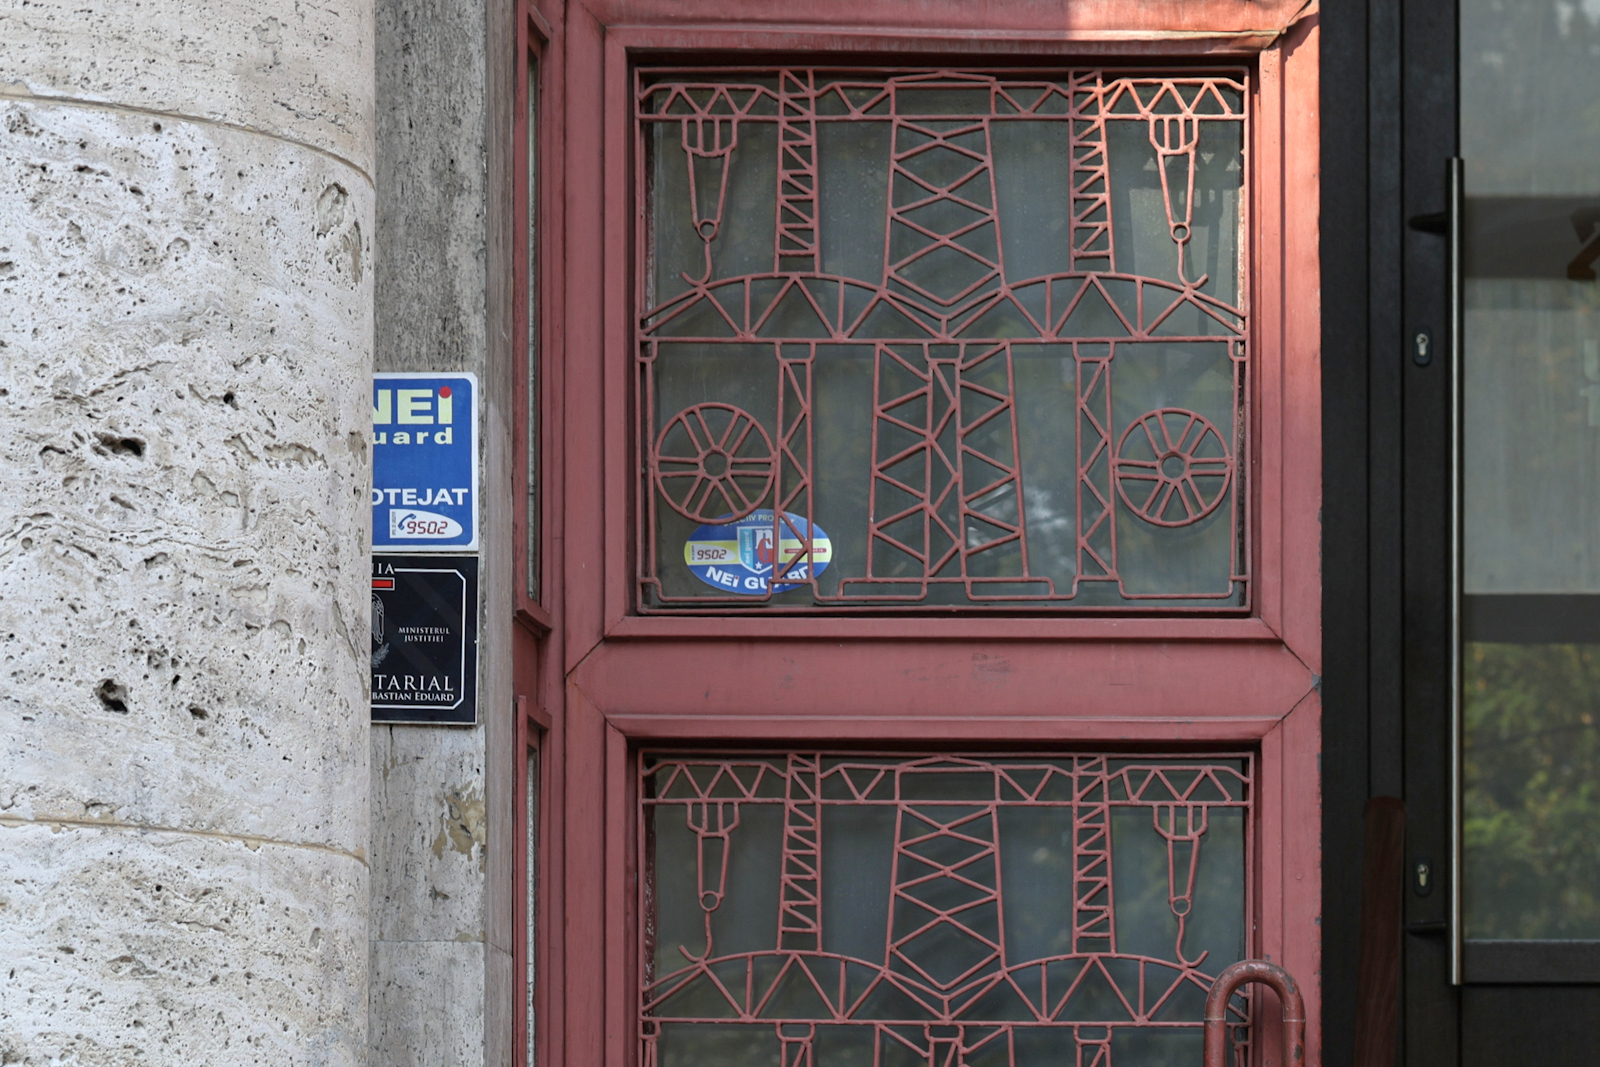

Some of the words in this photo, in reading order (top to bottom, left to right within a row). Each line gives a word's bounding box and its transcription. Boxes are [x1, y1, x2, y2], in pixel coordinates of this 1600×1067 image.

[373, 427, 453, 445] uard
[372, 488, 469, 506] OTEJAT
[406, 521, 448, 535] 9502
[696, 549, 728, 560] 9502
[398, 626, 450, 635] MINISTERUL
[373, 674, 454, 691] TARIAL
[372, 691, 412, 701] BASTIAN
